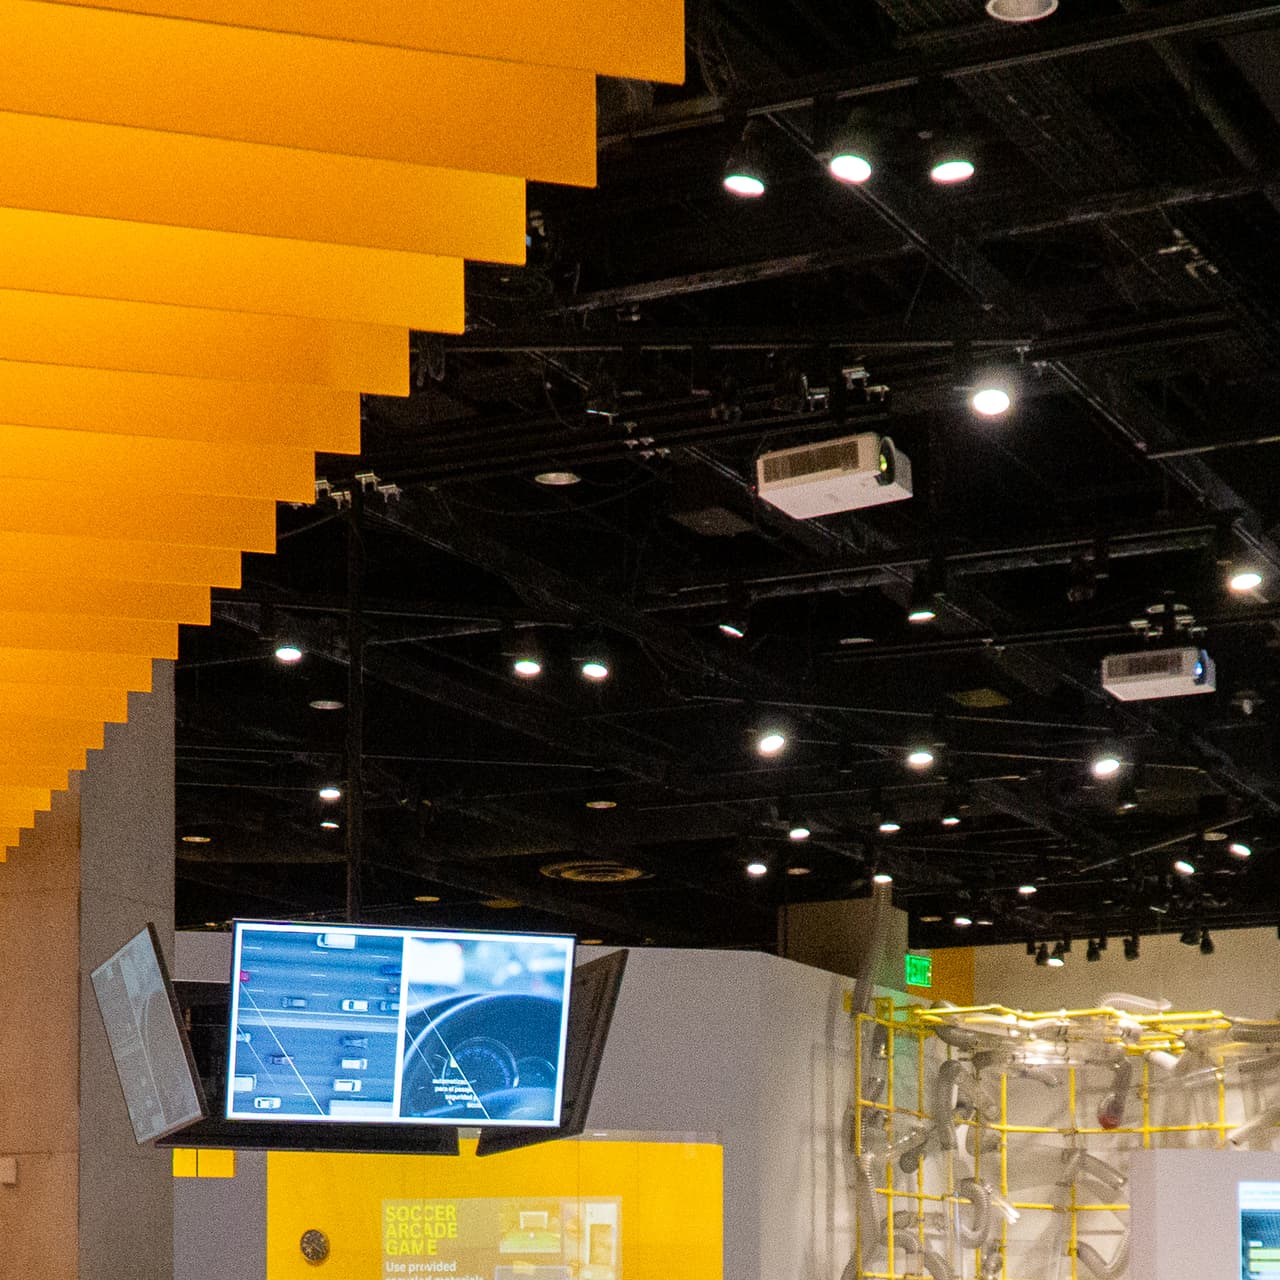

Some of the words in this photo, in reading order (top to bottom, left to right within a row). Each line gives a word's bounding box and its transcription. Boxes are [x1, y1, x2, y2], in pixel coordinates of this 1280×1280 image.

[386, 1204, 457, 1222] SOCCER
[386, 1222, 458, 1239] ARCADE
[385, 1239, 437, 1256] GAME
[386, 1262, 406, 1272] Use
[408, 1261, 457, 1275] provided
